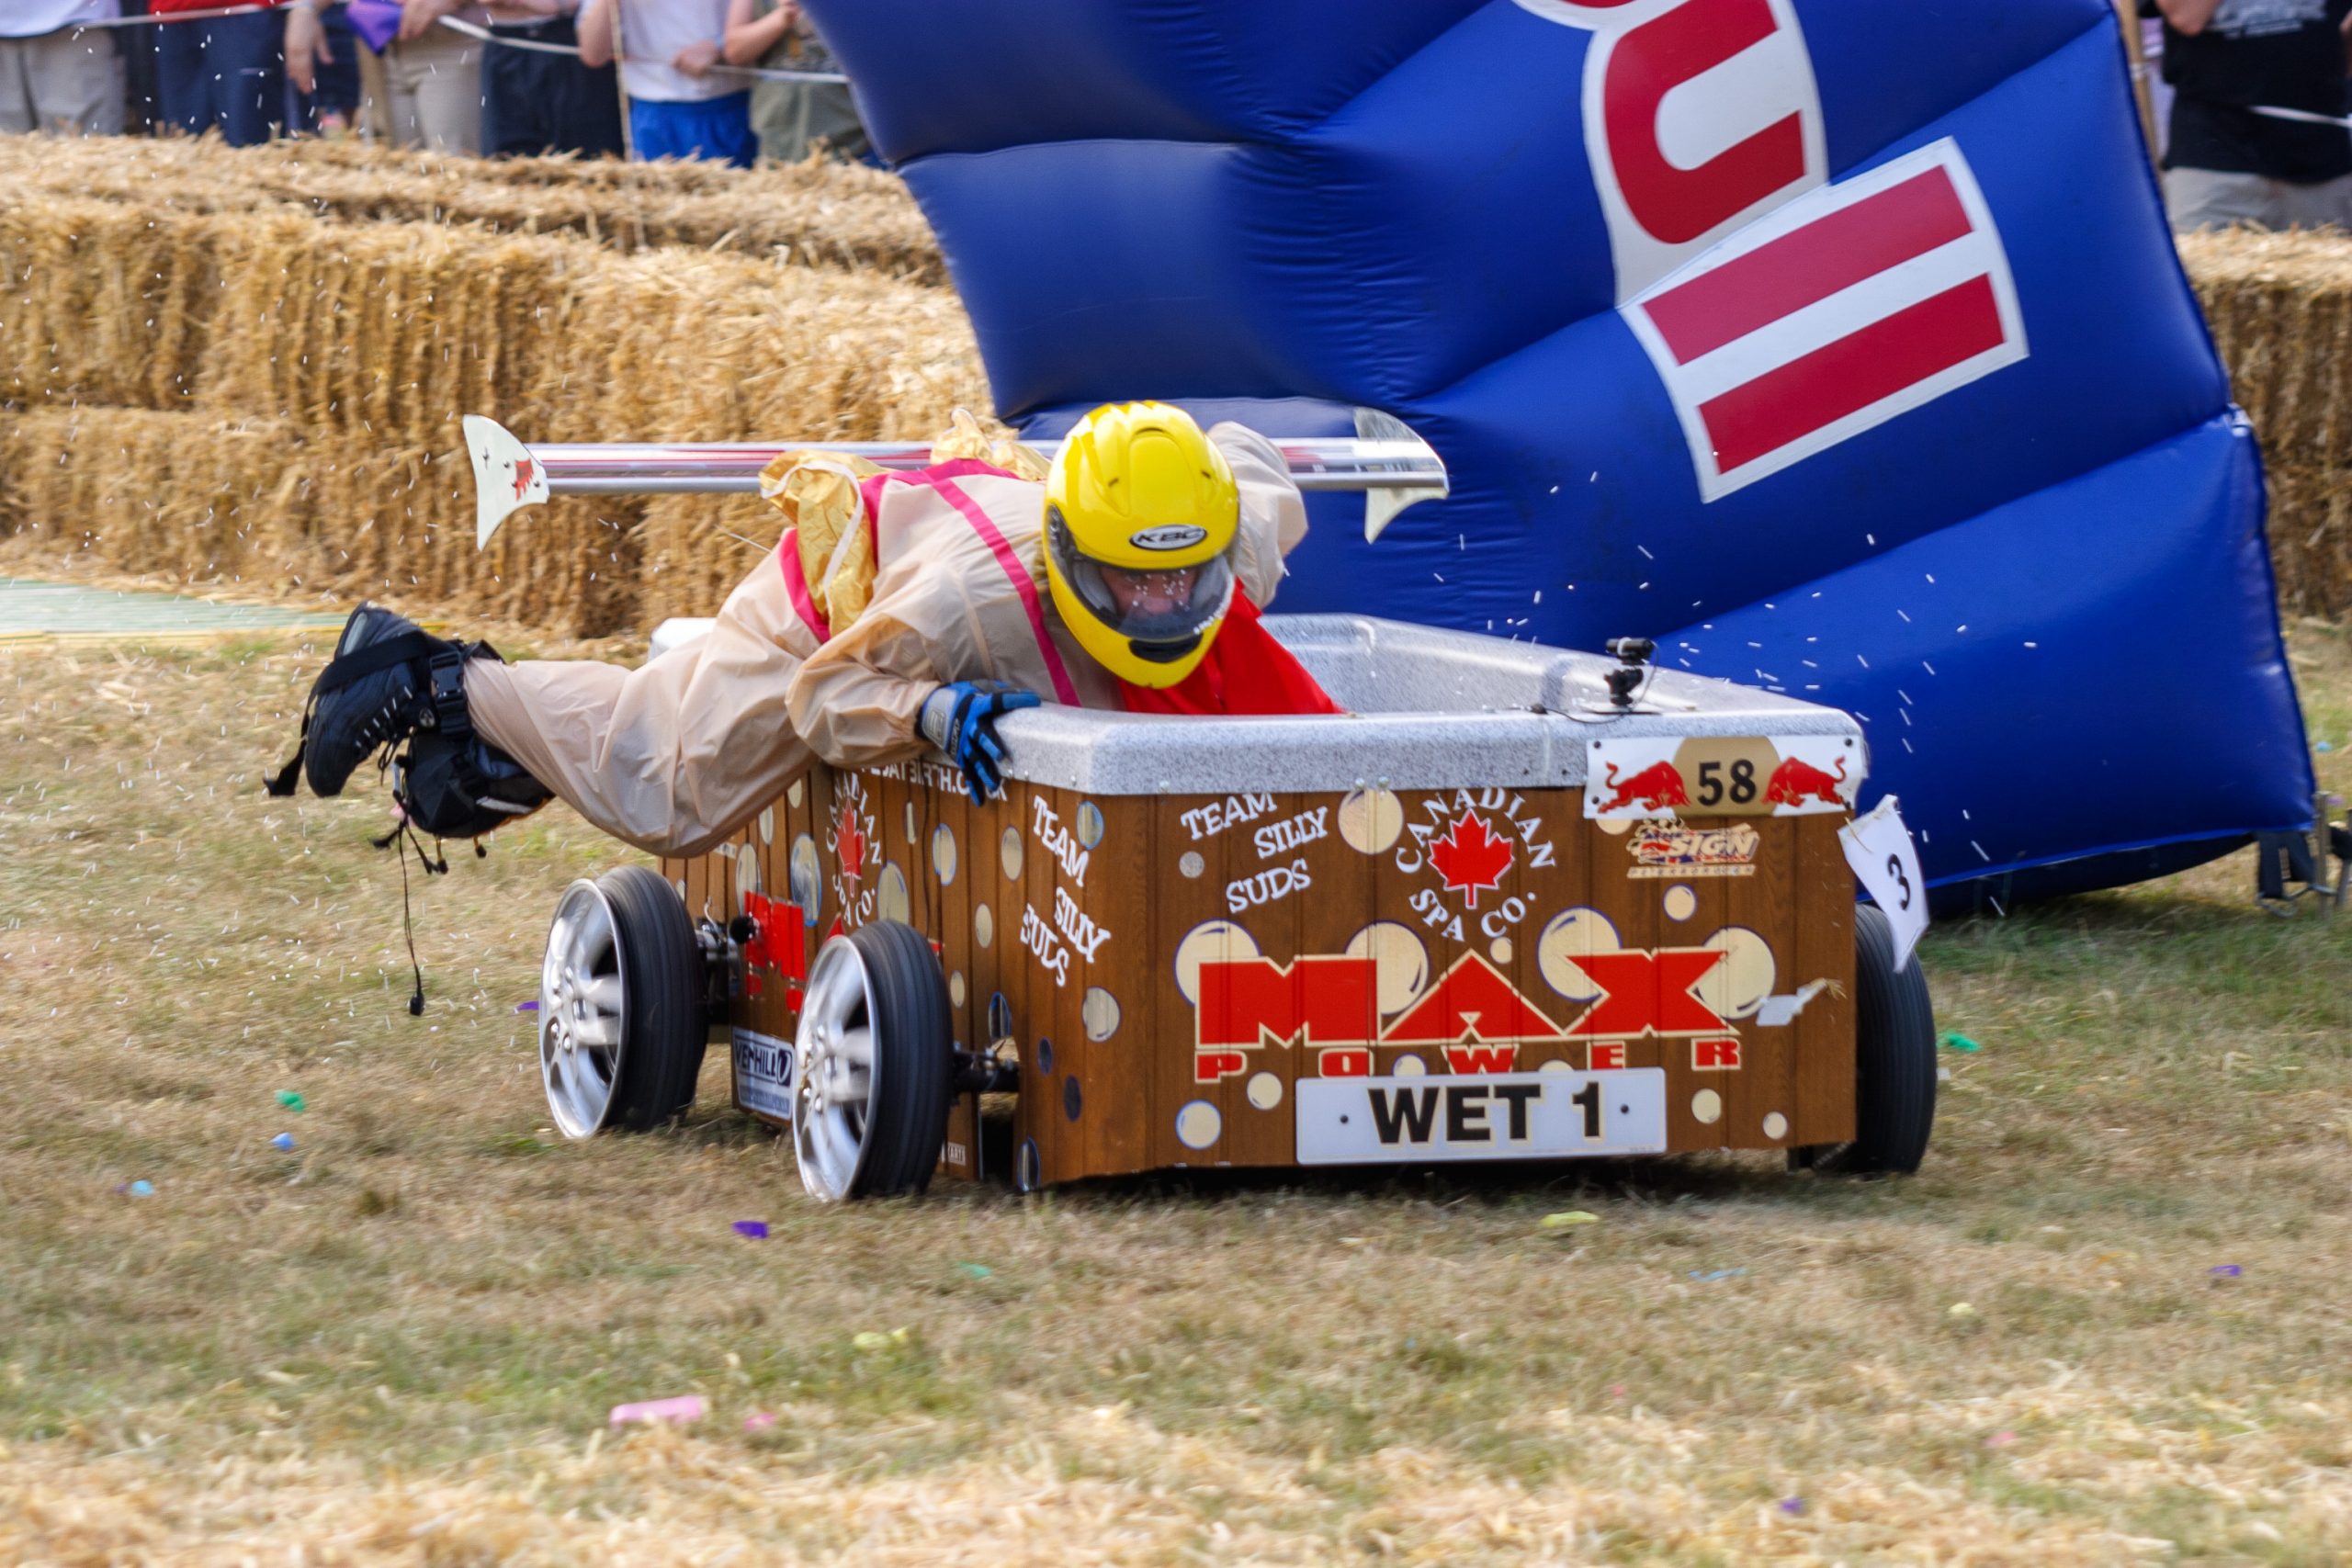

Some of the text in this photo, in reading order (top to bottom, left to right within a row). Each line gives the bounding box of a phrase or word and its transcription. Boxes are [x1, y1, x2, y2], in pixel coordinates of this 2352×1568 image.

[1553, 0, 2017, 487] ull
[1136, 527, 1204, 544] KBC
[1696, 759, 1757, 806] 58
[1034, 795, 1089, 887] TEAM
[1181, 792, 1278, 841] TEAM
[1253, 806, 1329, 859] SILLY
[1395, 787, 1556, 874] CANADIAN
[1226, 858, 1313, 914] SUDS
[1887, 853, 1912, 911] 3
[1055, 886, 1111, 963] SILLY
[1408, 887, 1537, 942] SPA CO.
[1196, 949, 1741, 1048] MAX
[1194, 1037, 1741, 1084] POWER
[1367, 1081, 1601, 1145] WET 1
